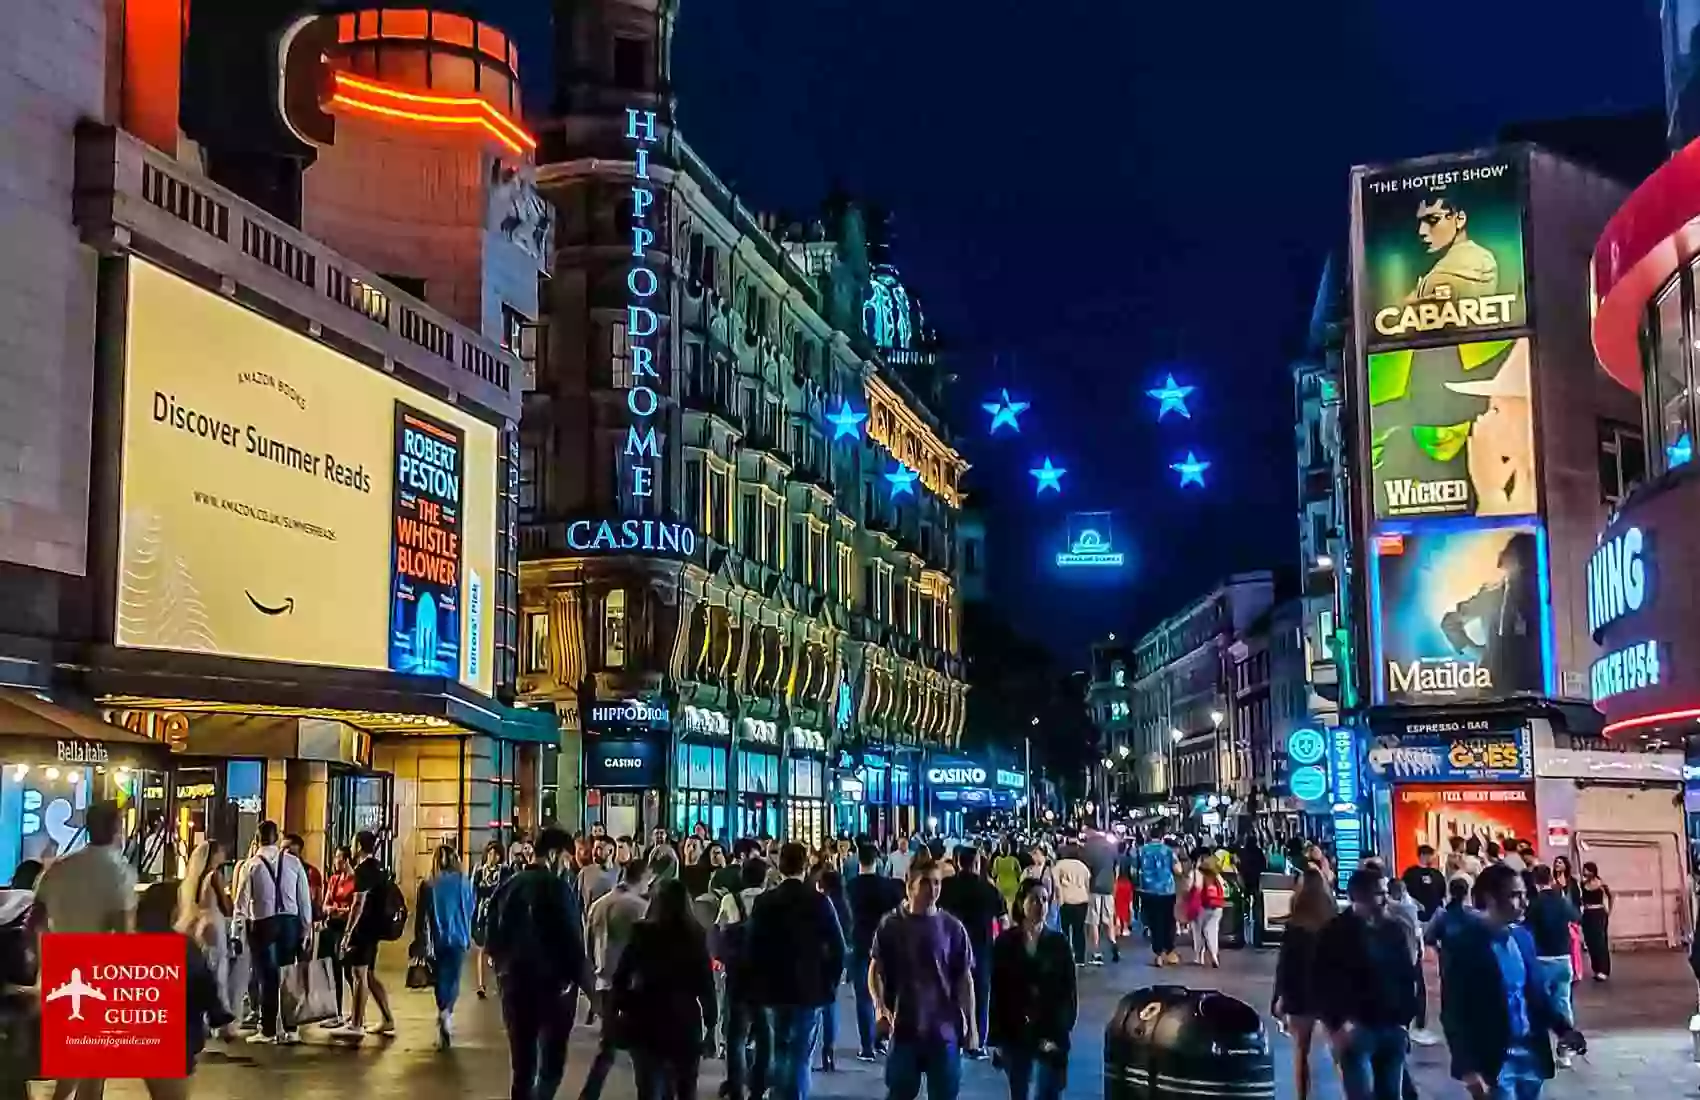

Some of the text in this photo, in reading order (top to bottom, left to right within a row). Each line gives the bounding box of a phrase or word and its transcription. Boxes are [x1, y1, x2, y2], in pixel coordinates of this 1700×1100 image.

[1402, 171, 1459, 190] HOTTEST
[624, 107, 661, 497] HIPPODROME
[1374, 294, 1517, 336] CABARET
[237, 371, 308, 411] AMAZON BOOKS
[153, 390, 372, 494] Discover Summer Reads
[404, 428, 457, 472] ROBERT
[399, 453, 459, 503] PESTON
[417, 498, 440, 525] THE
[397, 515, 459, 559] WHISTLE
[566, 519, 696, 556] CASINO
[397, 546, 457, 587] BLOWER
[1388, 660, 1493, 692] Matilda
[1621, 639, 1660, 693] 1954
[1406, 720, 1489, 734] ESPRESSO BAR
[57, 740, 109, 762] Bella Italia
[604, 758, 642, 769] CASINO
[927, 767, 987, 784] CASINO
